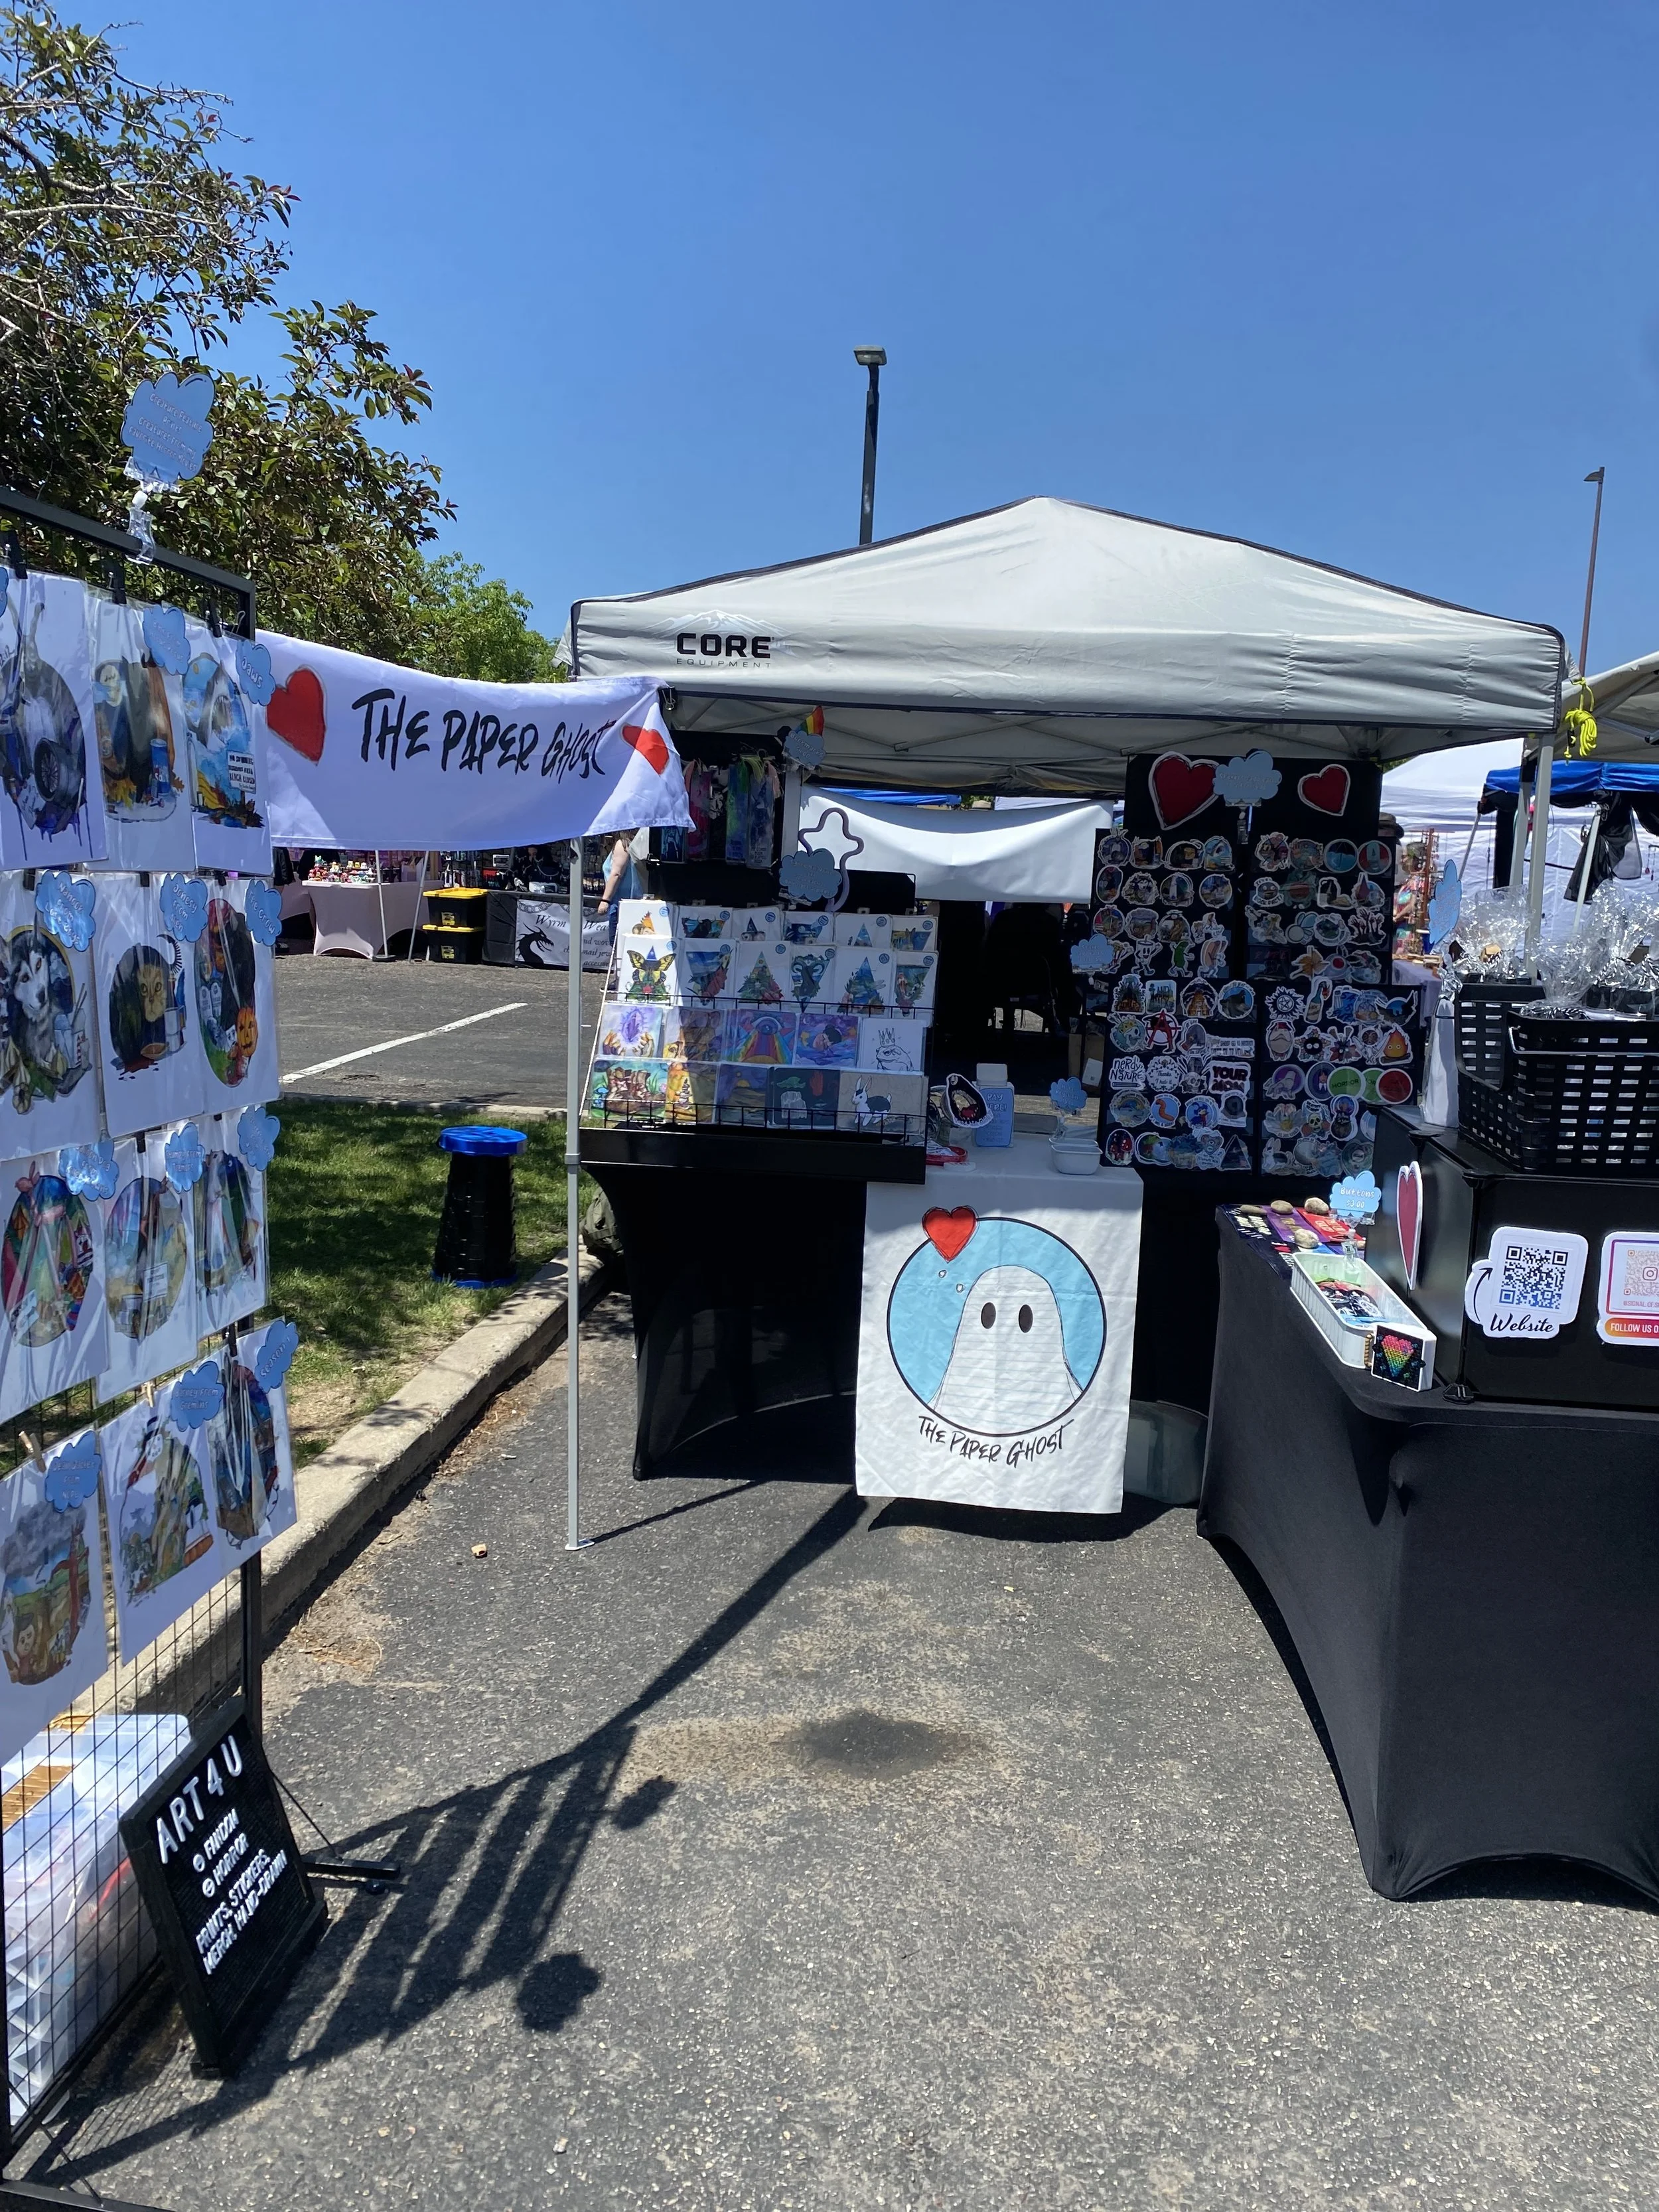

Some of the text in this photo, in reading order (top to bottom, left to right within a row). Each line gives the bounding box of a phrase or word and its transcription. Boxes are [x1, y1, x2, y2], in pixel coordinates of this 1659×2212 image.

[676, 632, 771, 659] CORE
[241, 656, 264, 689] Jaws
[676, 658, 772, 668] EQUIPMENT
[350, 688, 616, 784] THE PAPER GHOST
[173, 884, 198, 914] Jonesy
[258, 909, 276, 934] Crow
[535, 915, 566, 929] Wyrm
[1212, 1065, 1248, 1081] YOUR
[987, 1092, 1004, 1101] PAY
[1340, 1187, 1375, 1199] Buttons
[1490, 1313, 1554, 1333] Website
[1610, 1323, 1659, 1334] FOLLOW US O
[918, 1416, 1075, 1468] THE PAPER GHOST
[157, 1734, 242, 1864] ART 4 U
[212, 1832, 250, 1886] HORROR
